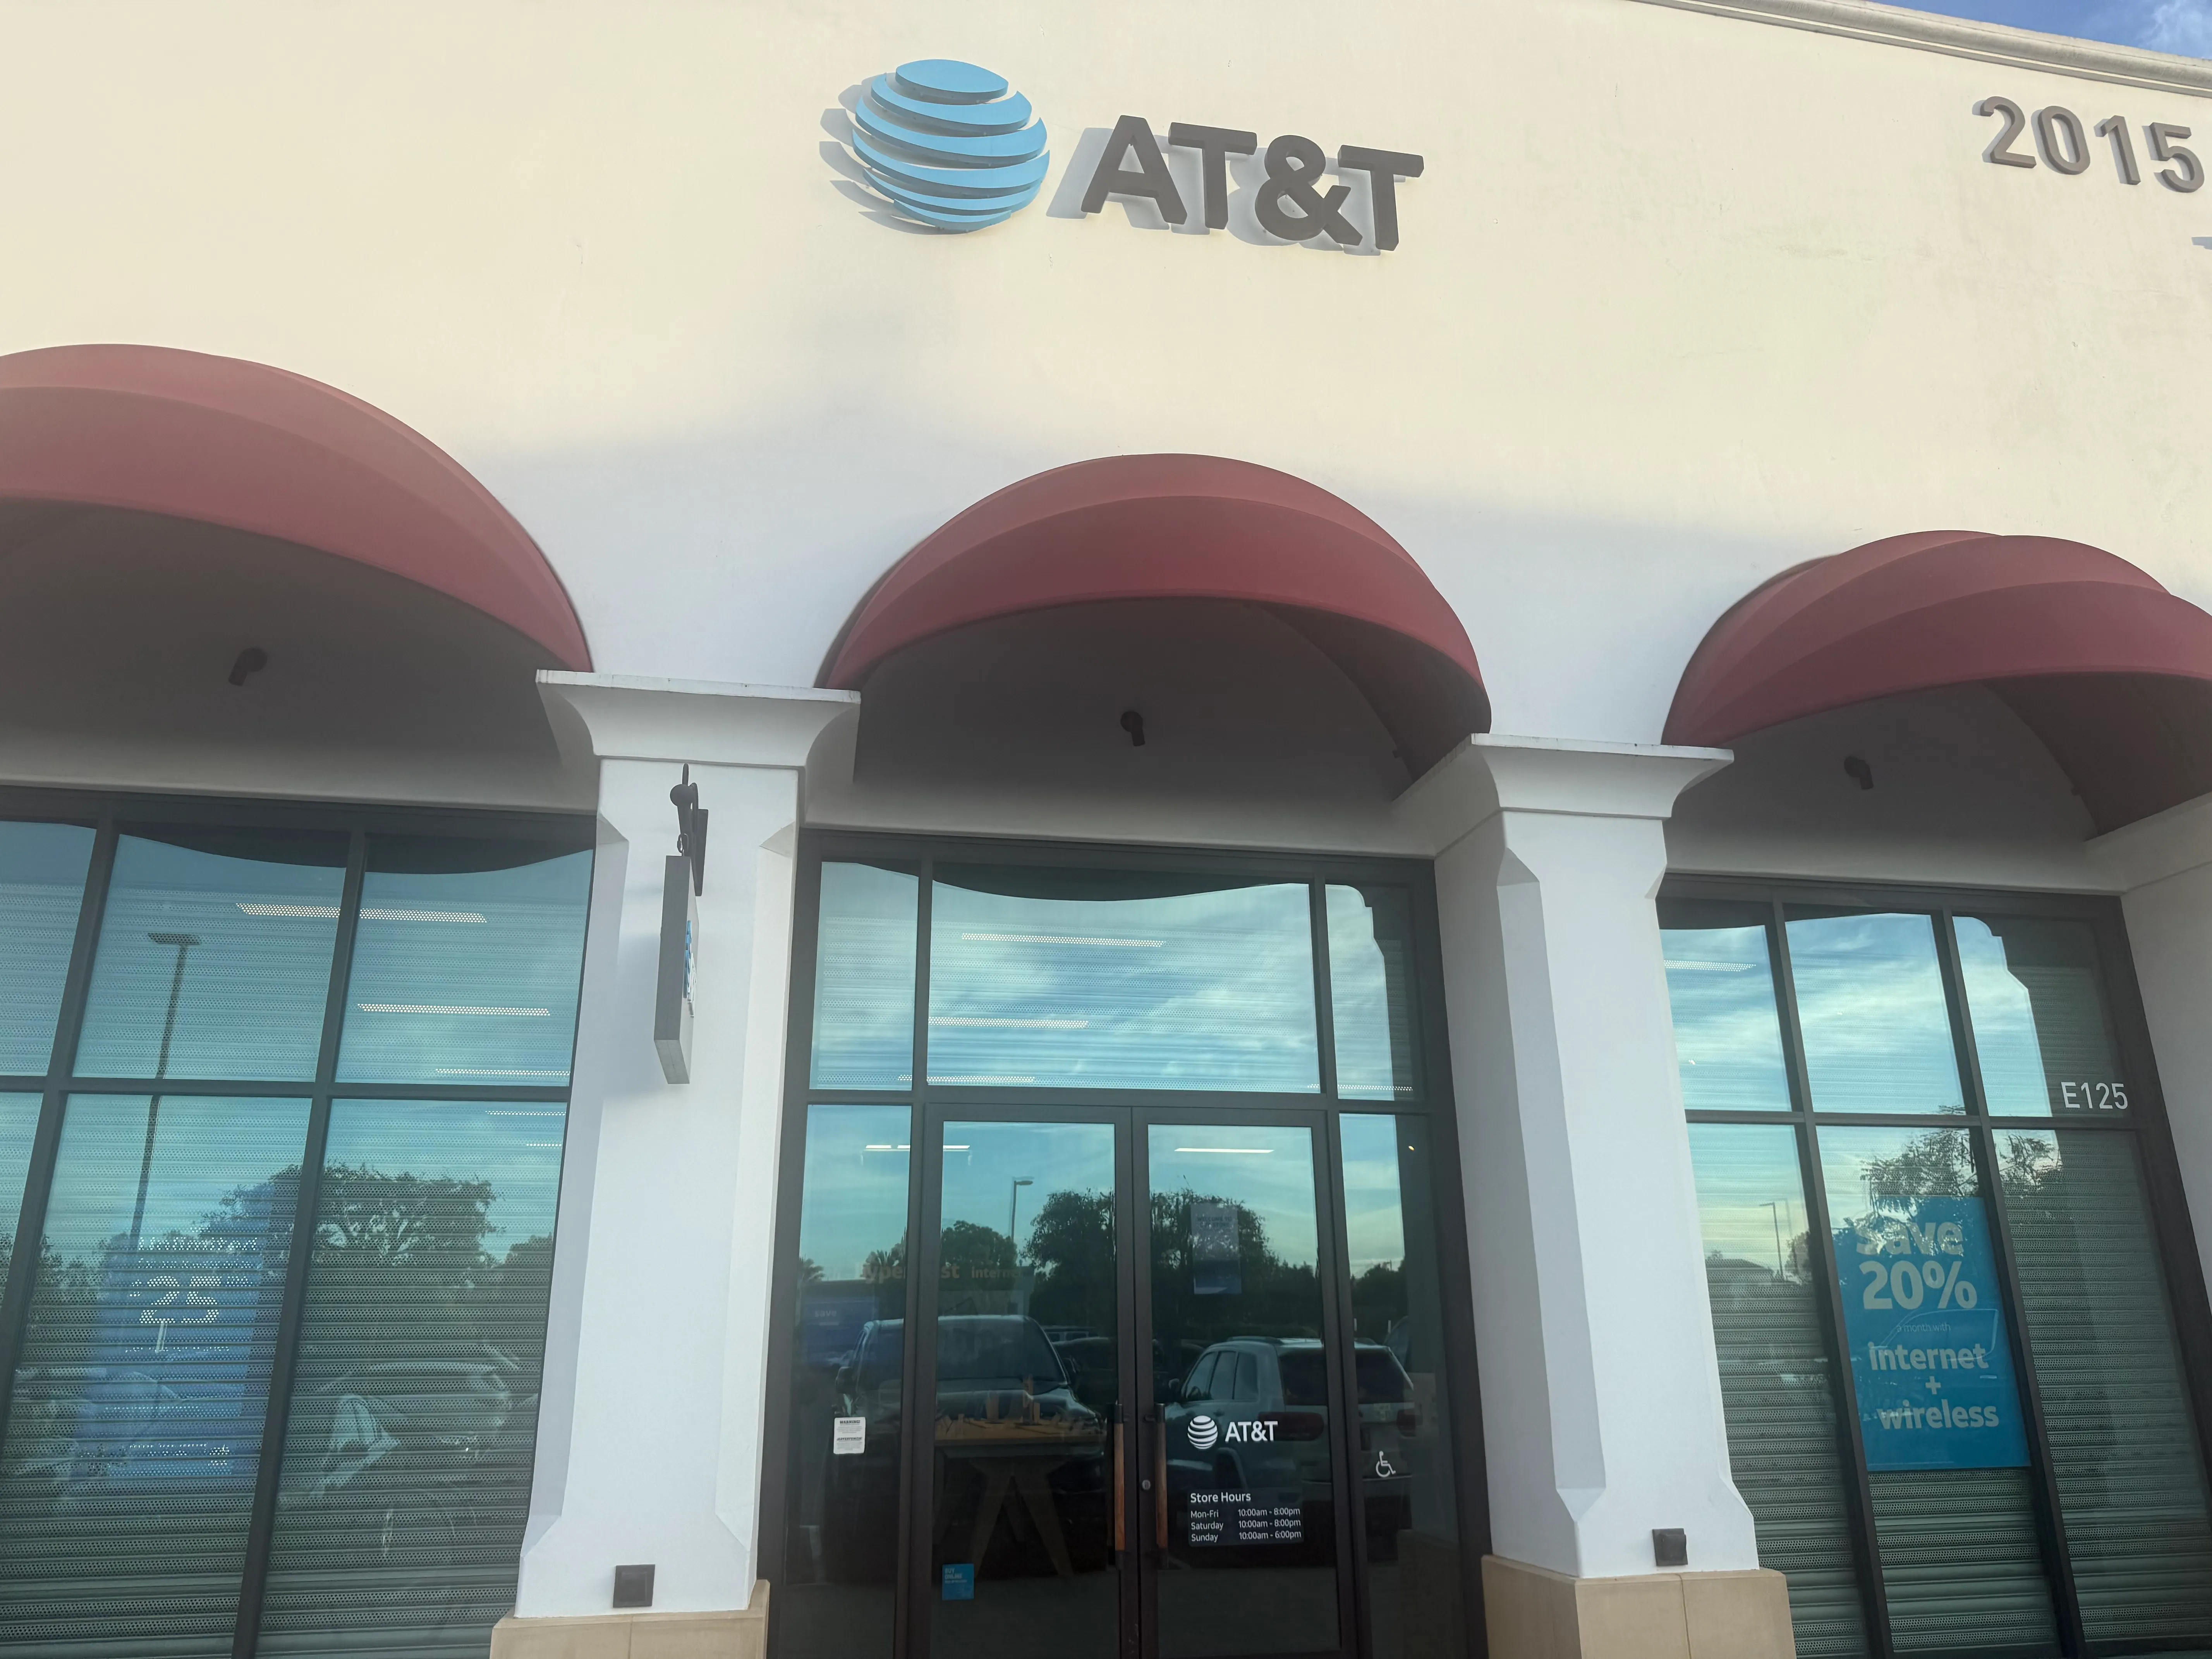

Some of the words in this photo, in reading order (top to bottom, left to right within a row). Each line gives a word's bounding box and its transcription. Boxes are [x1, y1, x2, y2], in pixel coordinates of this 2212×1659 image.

[1980, 96, 2204, 193] 2015
[1081, 115, 1424, 251] AT&T
[2061, 1082, 2128, 1109] E125
[1854, 1221, 1965, 1255] save
[1859, 1260, 1977, 1310] 20%
[1904, 1323, 1931, 1332] month
[1932, 1322, 1951, 1332] with
[1868, 1341, 1989, 1370] internet
[1876, 1399, 1999, 1429] wireless
[1225, 1421, 1278, 1442] AT&T
[1190, 1493, 1218, 1503] Store
[1221, 1492, 1251, 1502] Hours
[1191, 1510, 1219, 1518] Mon-Fri
[1238, 1509, 1267, 1517] 10:00am
[1274, 1508, 1300, 1516] 8:00pm
[1191, 1521, 1224, 1530] Saturday
[1238, 1520, 1268, 1528] 10:00am
[1274, 1519, 1301, 1528] 8:00pm
[1191, 1533, 1218, 1542] Sunday
[1275, 1530, 1302, 1539] 6:00pm
